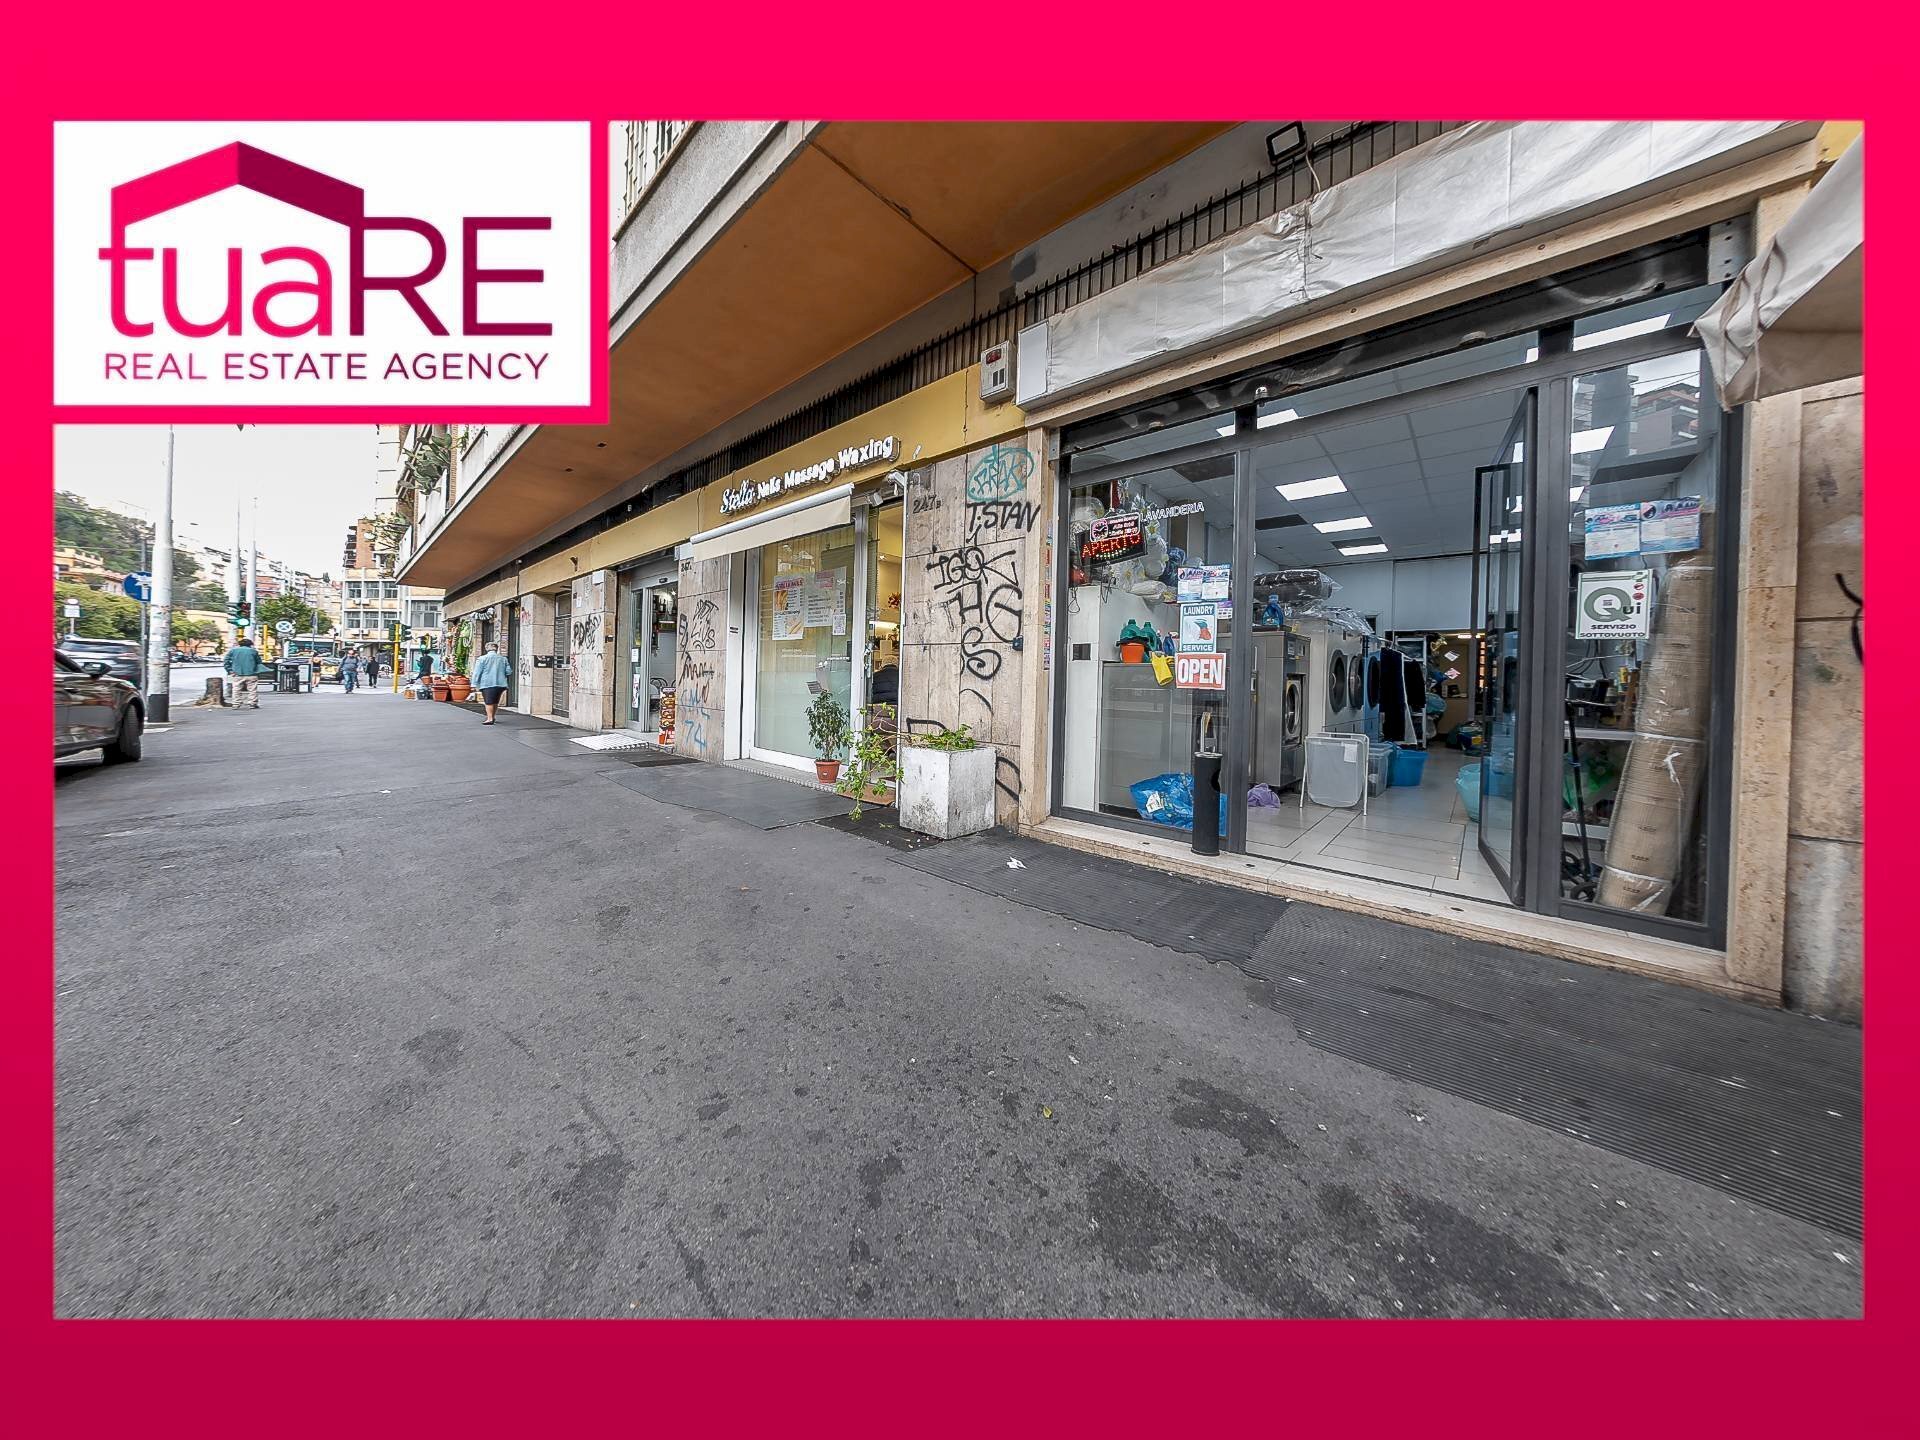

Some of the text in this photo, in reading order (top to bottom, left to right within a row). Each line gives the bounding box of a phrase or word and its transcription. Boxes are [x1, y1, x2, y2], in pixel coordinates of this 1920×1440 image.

[720, 480, 754, 513] Stella
[784, 457, 835, 489] Massage
[837, 436, 894, 468] Waxing
[1141, 501, 1205, 522] LAVANDERIA
[1082, 534, 1141, 558] APERTO
[1183, 605, 1214, 615] LAUNDRY
[1182, 644, 1213, 652] SERVICE
[1177, 658, 1223, 685] OPEN
